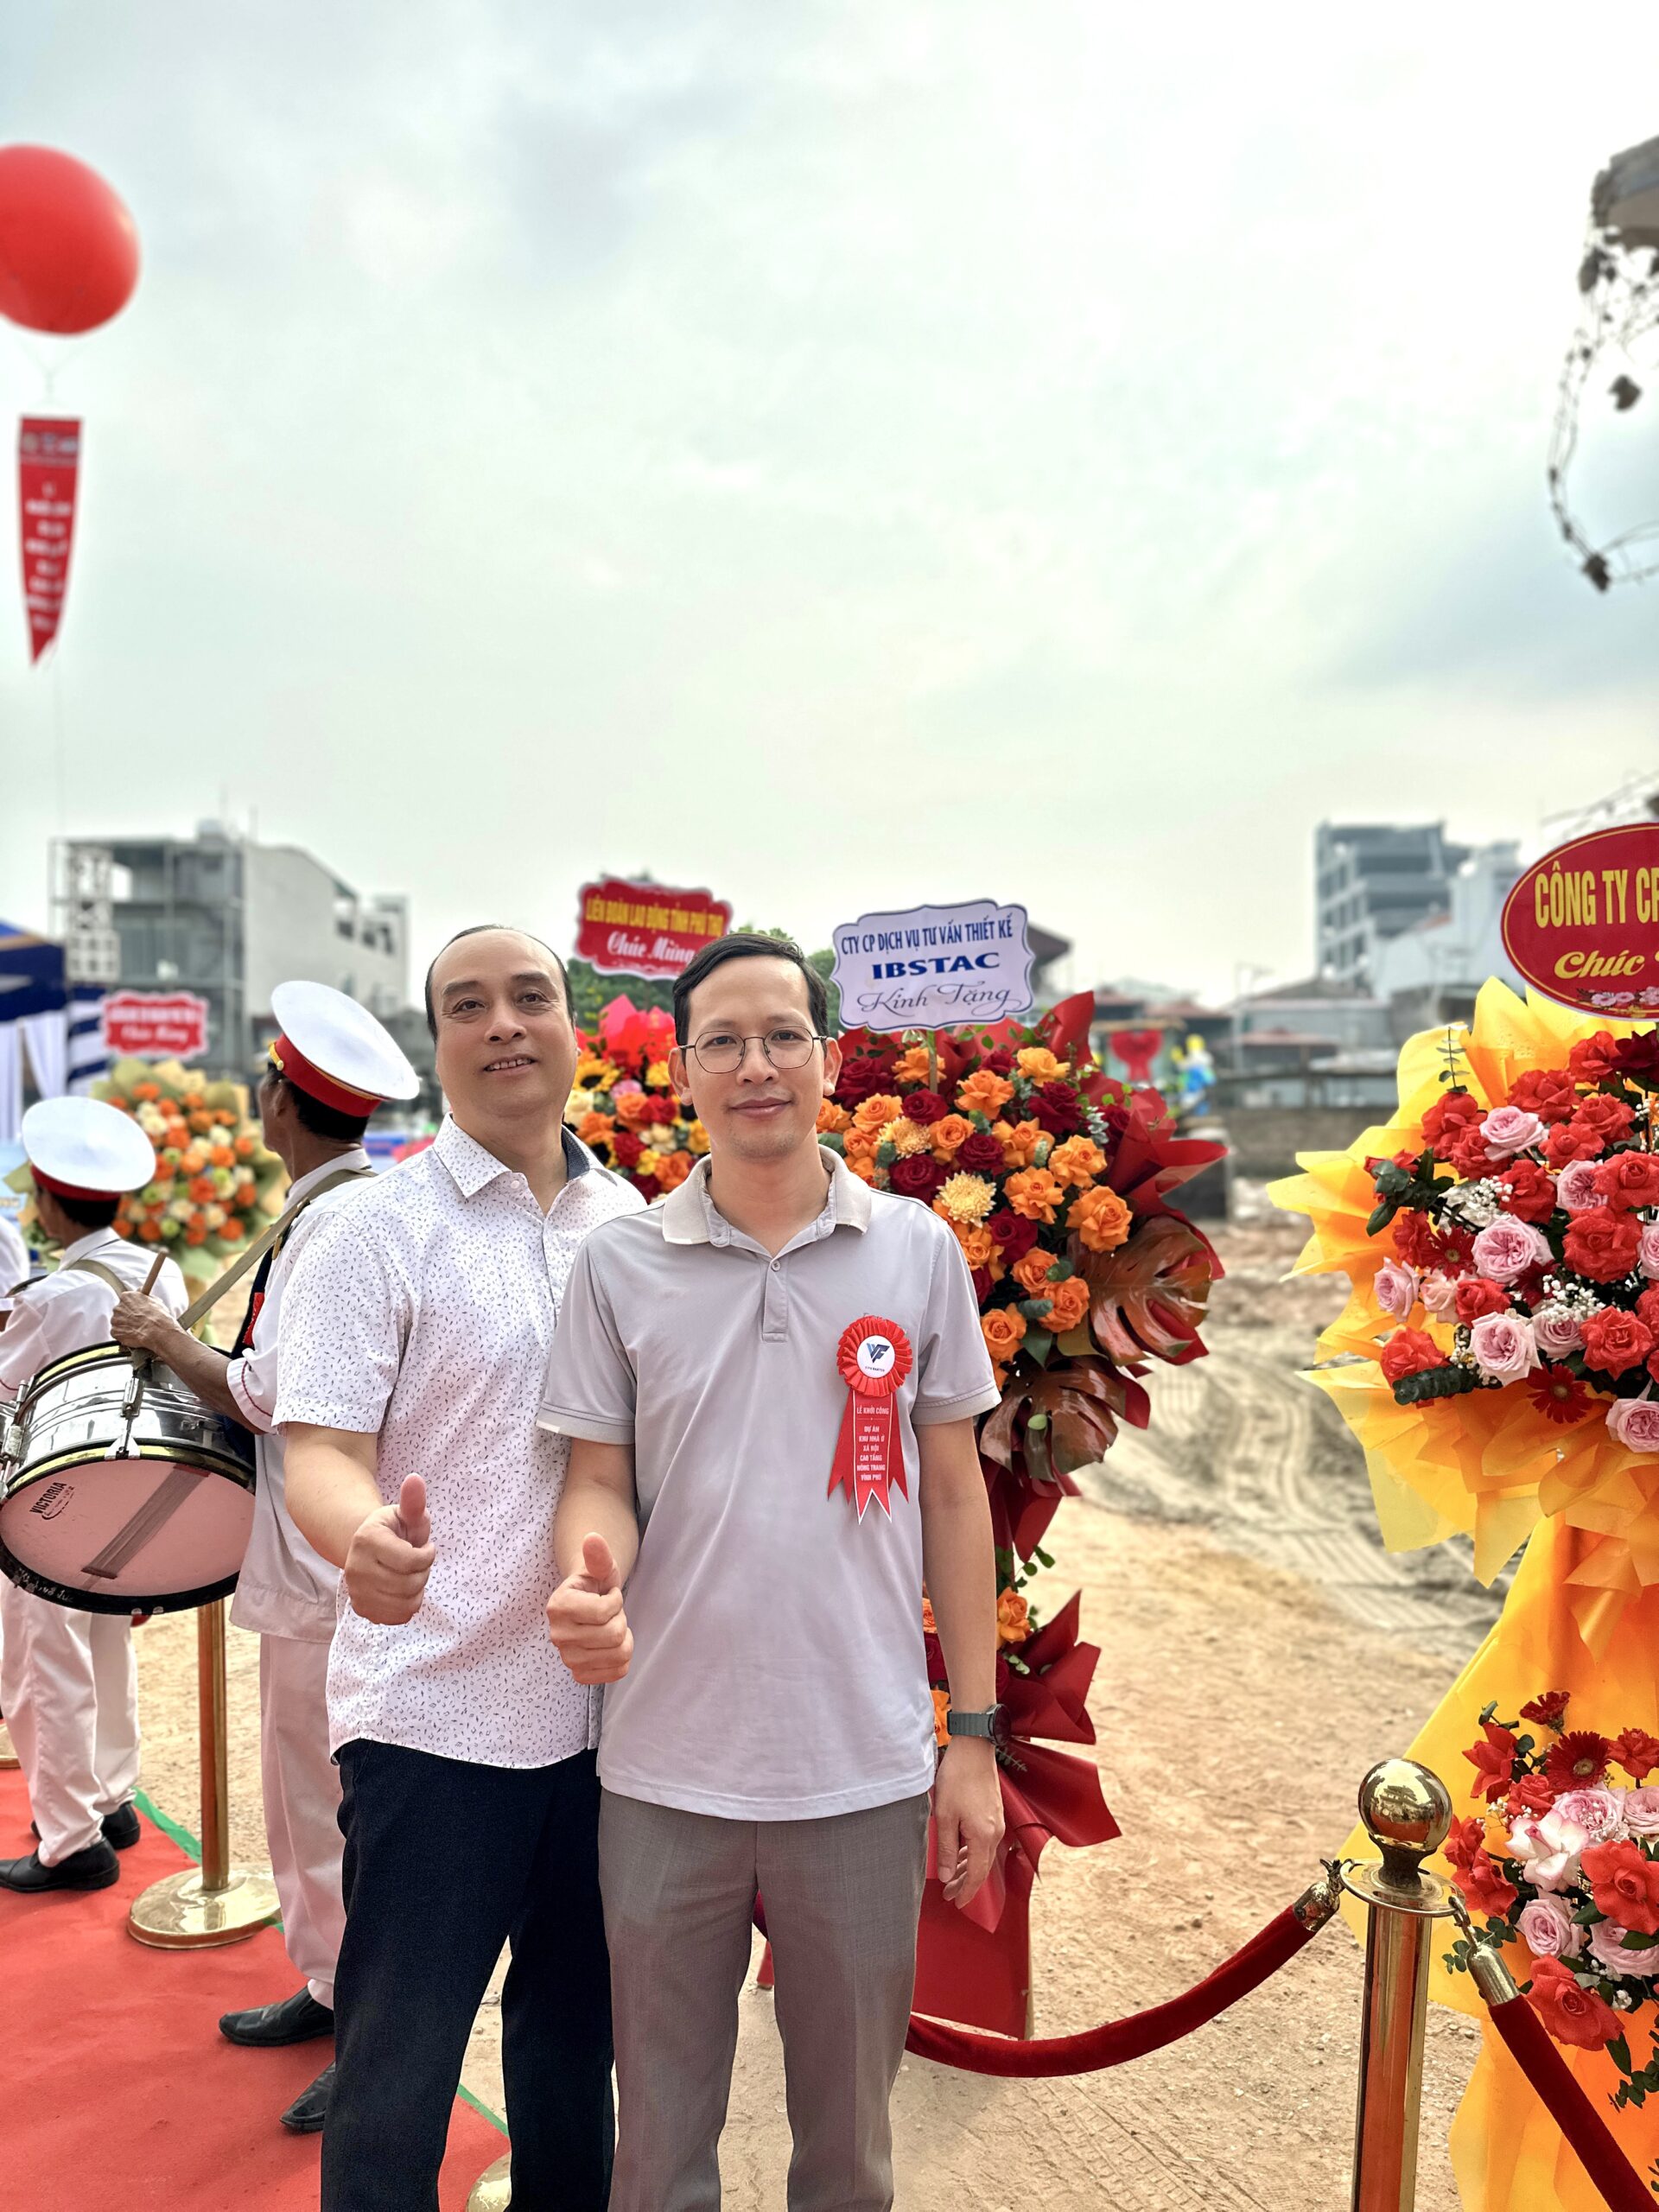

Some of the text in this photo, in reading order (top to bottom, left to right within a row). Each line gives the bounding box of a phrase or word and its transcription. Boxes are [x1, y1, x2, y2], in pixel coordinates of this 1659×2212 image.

[1535, 861, 1596, 928] CÔNG
[1602, 868, 1628, 925] TY
[607, 931, 647, 957] Chúc
[842, 912, 1013, 955] CTY CP DỊCH VỤ TƯ VẤN THIẾT KẾ
[872, 952, 1000, 980] IBSTAC
[1554, 950, 1645, 980] Chúc
[937, 981, 1022, 1016] Tặng
[875, 1406, 889, 1415] CÔNG
[29, 1482, 67, 1514] VICTORIA
